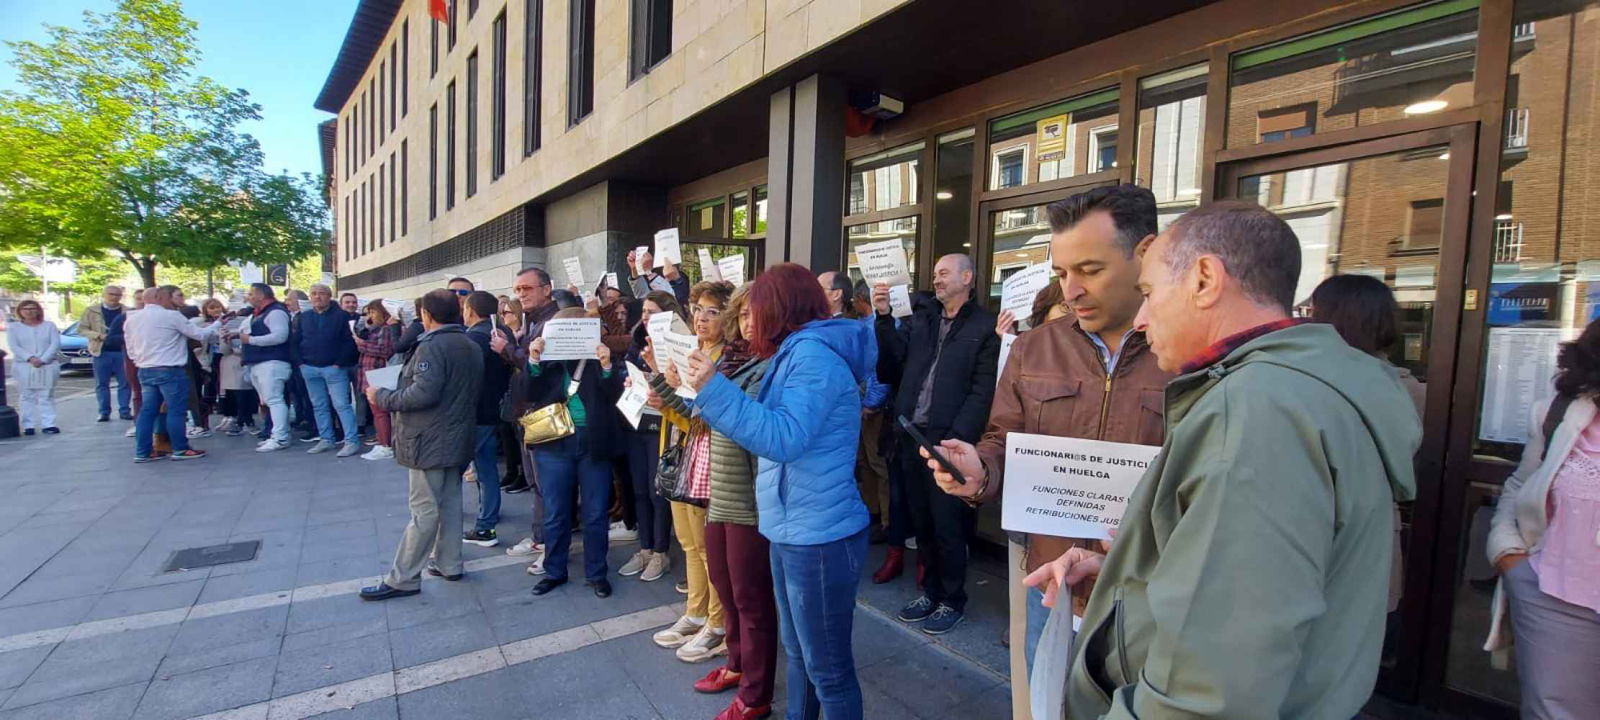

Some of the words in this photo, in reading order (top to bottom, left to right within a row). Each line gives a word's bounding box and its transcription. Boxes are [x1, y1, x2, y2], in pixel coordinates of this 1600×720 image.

[1090, 455, 1103, 463] DE
[1106, 458, 1148, 469] JUSTICI
[1053, 465, 1067, 474] EN
[1069, 467, 1110, 479] HUELGA
[1032, 485, 1085, 498] FUNCIONES
[1086, 491, 1125, 503] CLARAS
[1056, 498, 1106, 511] DEFINIDAS
[1025, 506, 1099, 523] RETRIBUCIONES
[1100, 517, 1120, 526] JUS
